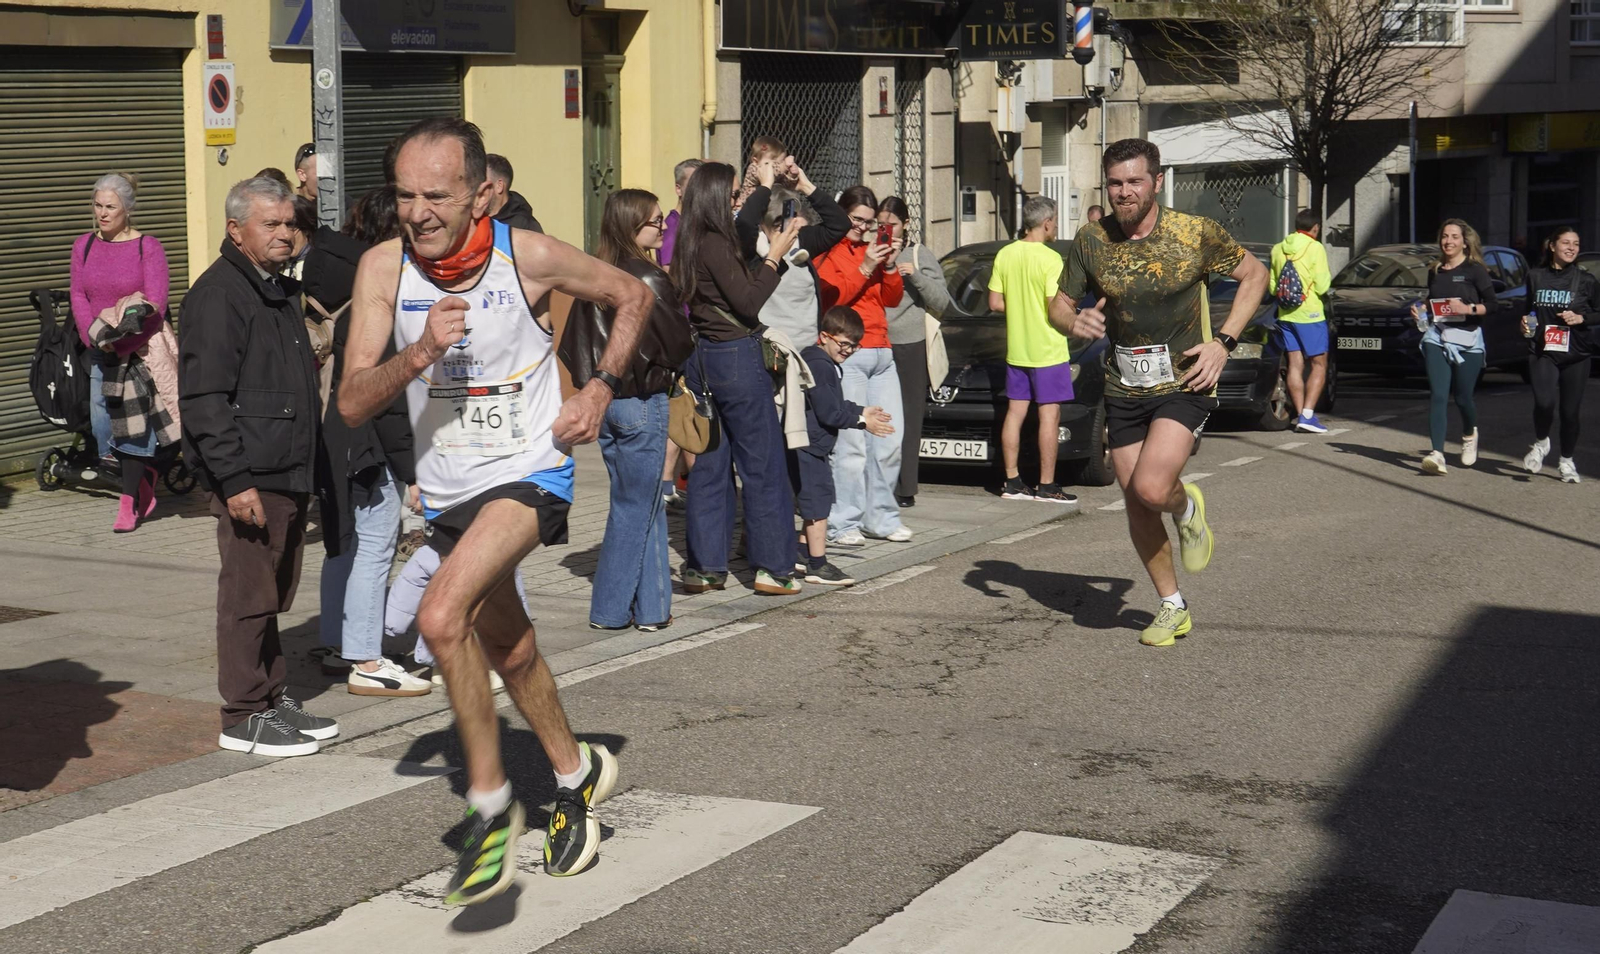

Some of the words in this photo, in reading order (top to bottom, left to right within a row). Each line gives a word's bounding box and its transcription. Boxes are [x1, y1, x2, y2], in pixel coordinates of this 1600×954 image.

[391, 29, 436, 45] elevación
[965, 21, 1056, 46] TIMES
[208, 118, 232, 126] VADO
[1536, 289, 1571, 304] TIERRA
[1361, 339, 1379, 348] NBT
[1545, 332, 1560, 342] 674
[1131, 359, 1150, 373] 70
[454, 405, 502, 429] 146
[920, 441, 948, 456] 457
[953, 442, 983, 457] CHZ
